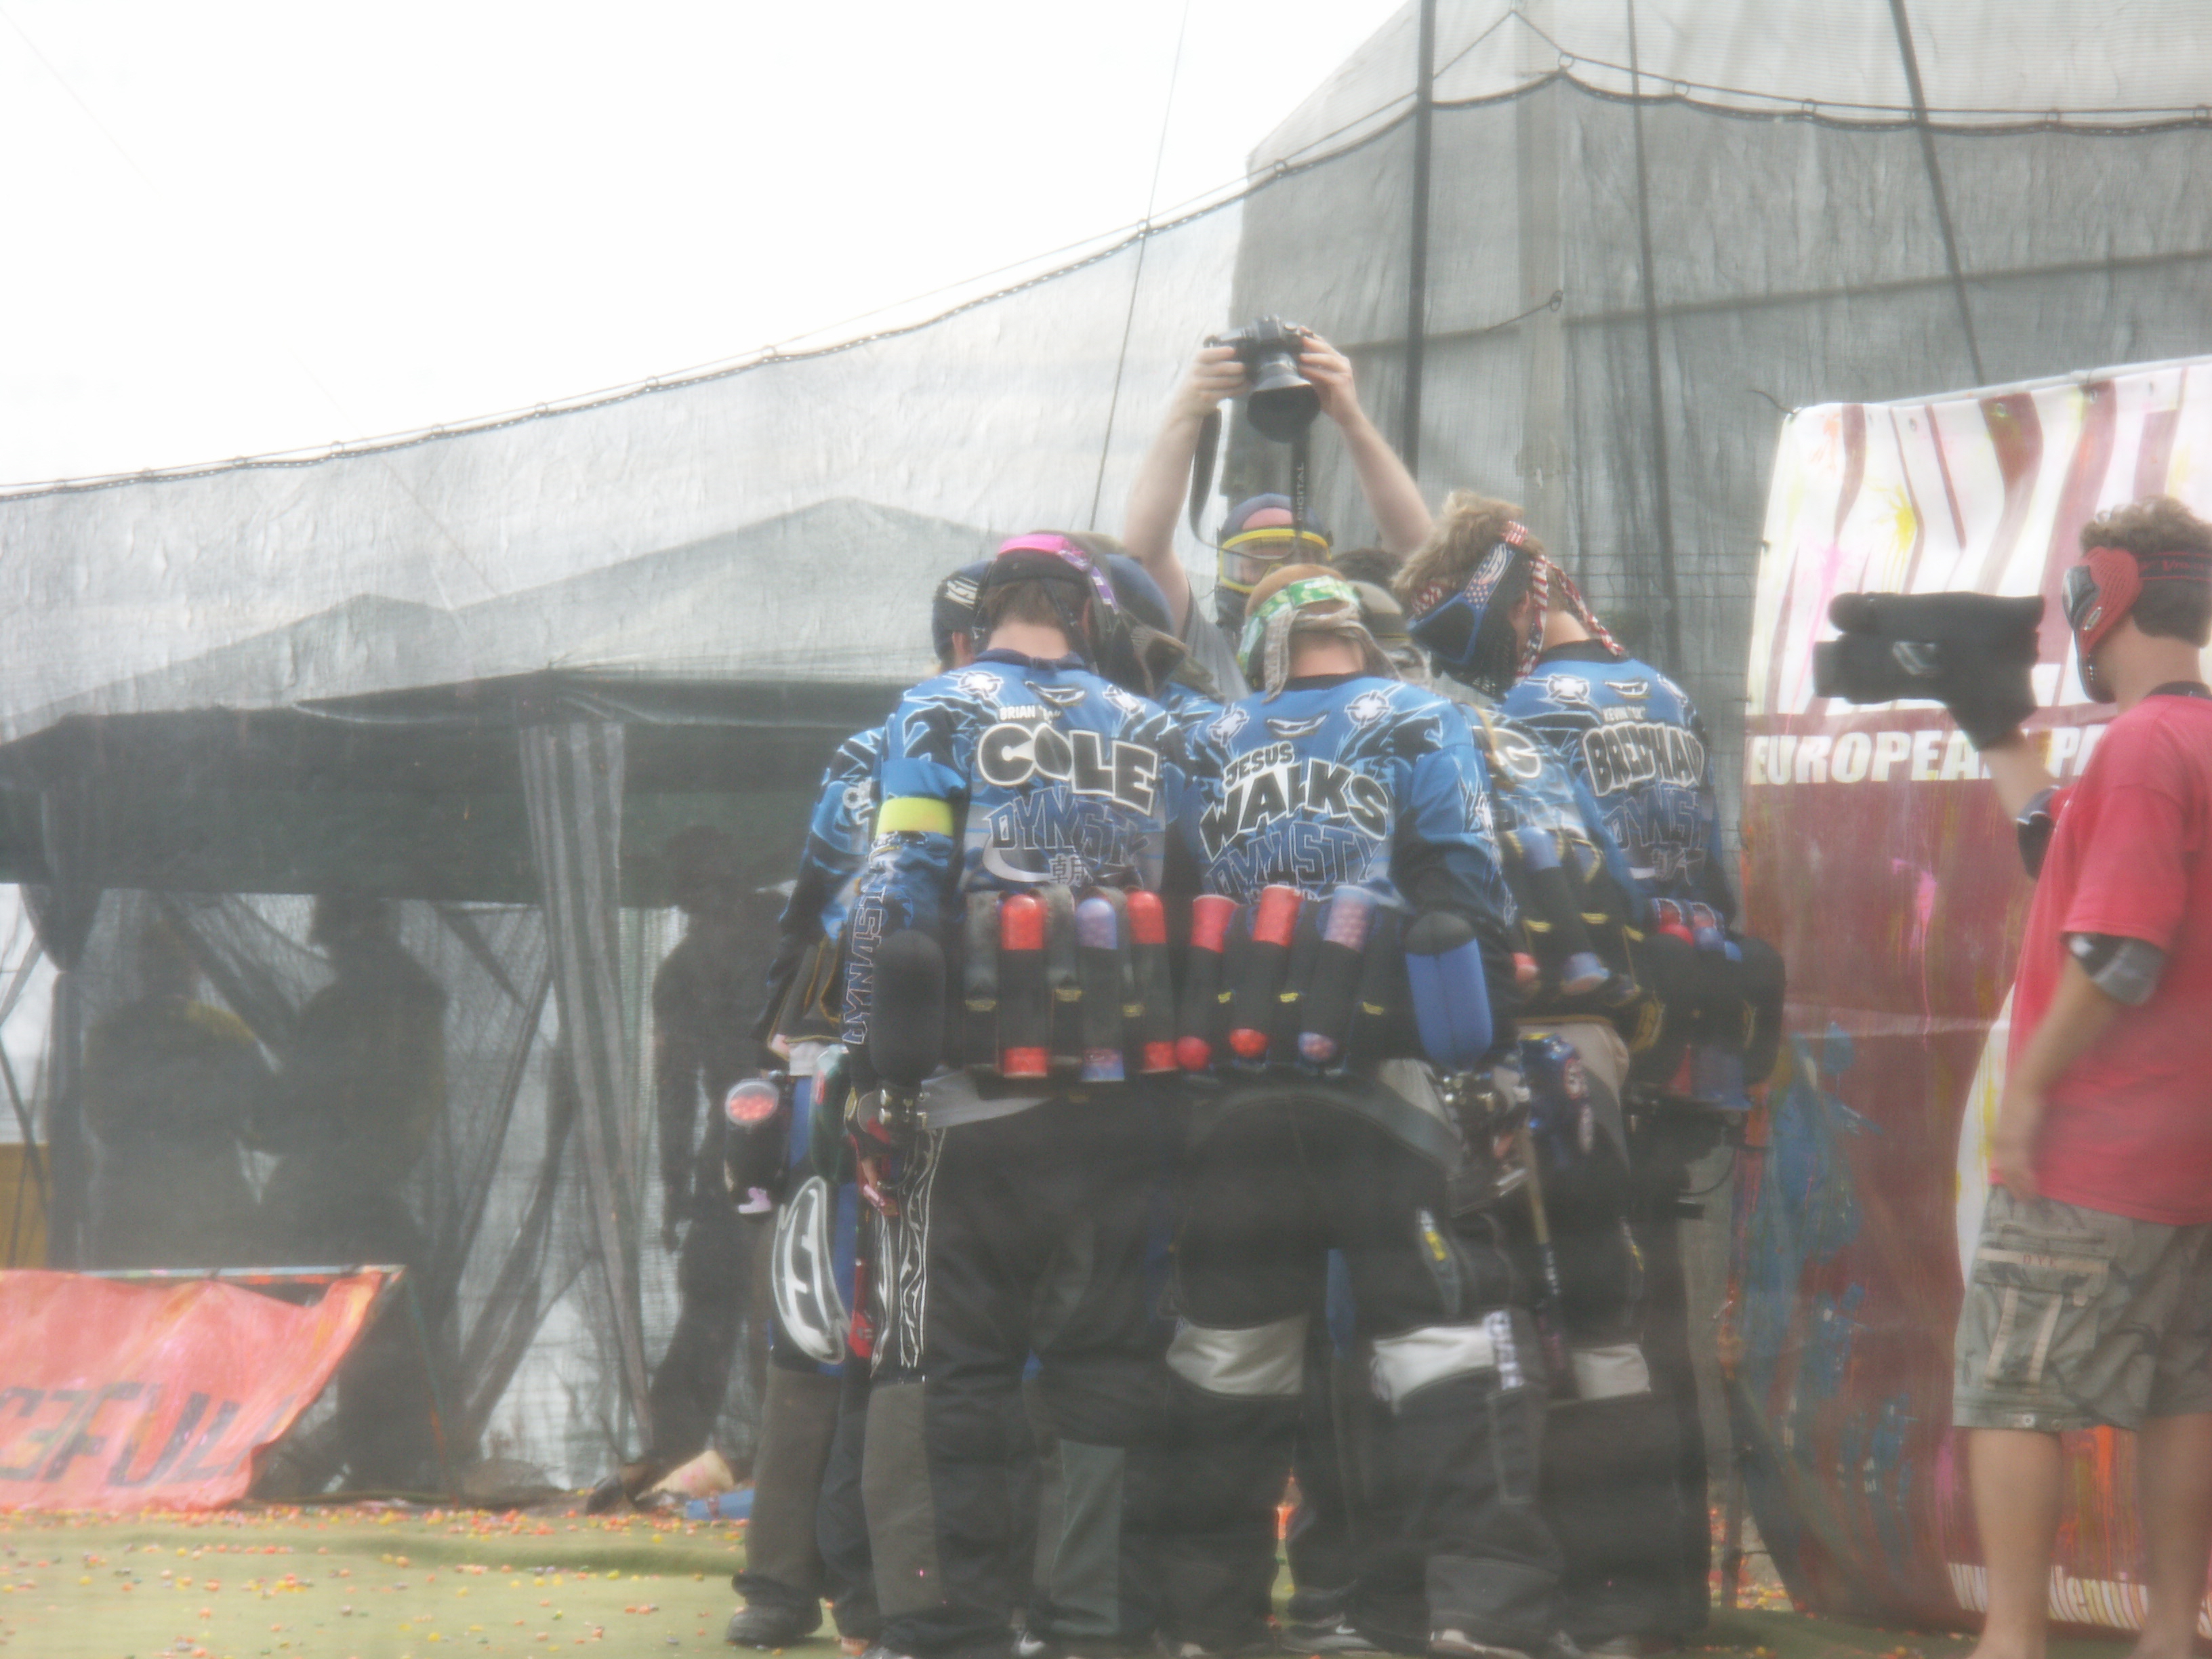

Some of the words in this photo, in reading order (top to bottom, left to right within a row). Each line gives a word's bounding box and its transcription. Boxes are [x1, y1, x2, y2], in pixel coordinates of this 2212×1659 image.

[999, 704, 1037, 721] BRIAN
[977, 722, 1160, 817] COLE
[1224, 741, 1295, 787] JESUS
[1749, 729, 2029, 785] EUROPEA
[1199, 757, 1390, 864] WALKS
